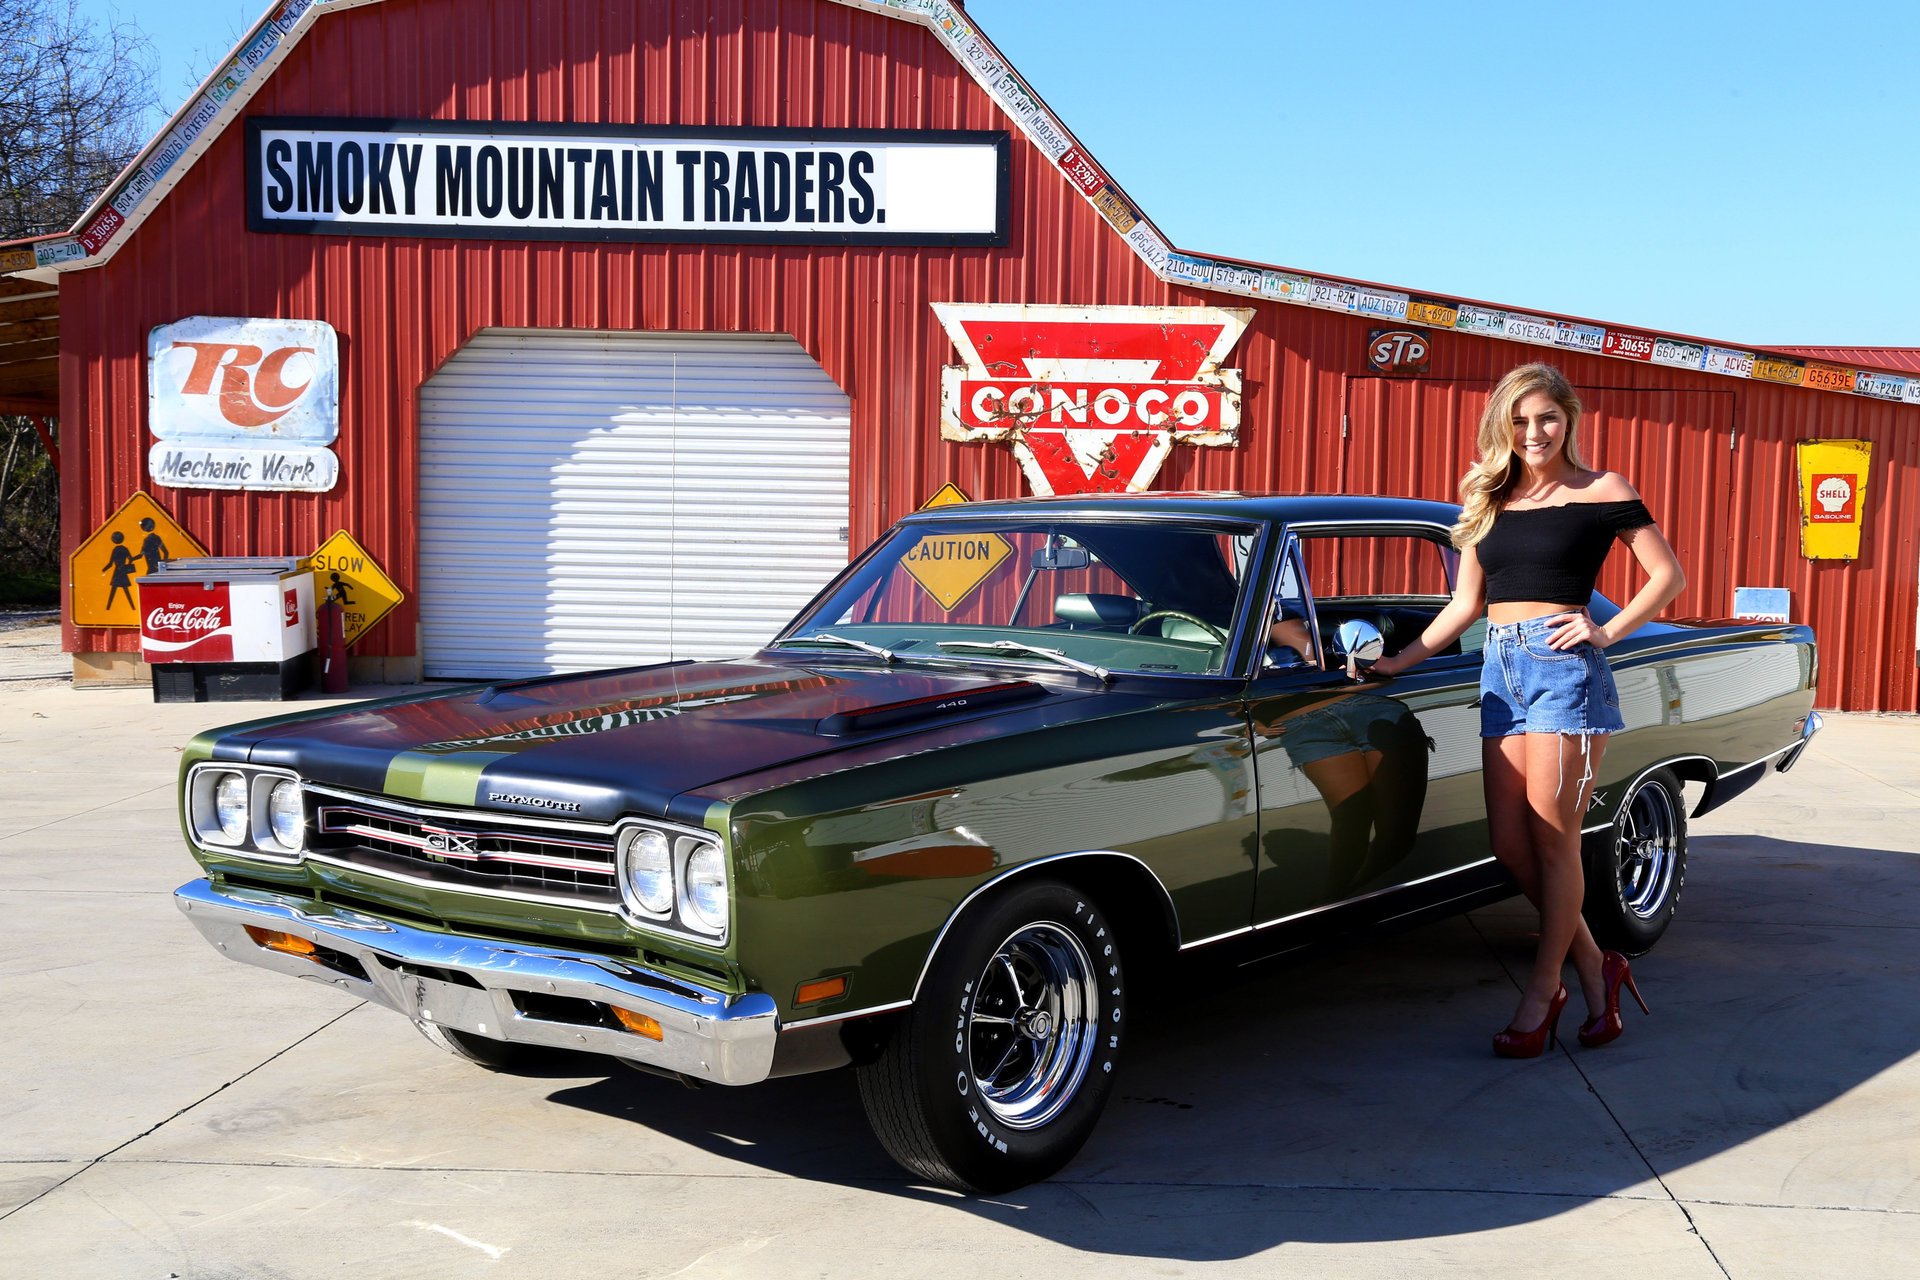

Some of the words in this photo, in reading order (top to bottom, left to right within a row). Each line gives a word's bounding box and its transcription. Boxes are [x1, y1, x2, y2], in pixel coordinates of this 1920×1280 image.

[184, 104, 217, 140] 6TXF815
[1031, 116, 1066, 154] N303652
[266, 139, 423, 215] SMOKY
[436, 144, 663, 222] MOUNTAIN
[676, 150, 885, 224] TRADERS.
[1129, 230, 1165, 267] 6PGJ412
[1315, 286, 1355, 305] 921-RZM
[1361, 295, 1406, 314] ADZ1678
[1508, 322, 1551, 340] 6SYE364
[1617, 332, 1644, 341] TENNESSEE
[1375, 336, 1425, 366] STP
[172, 341, 315, 427] RC
[1809, 369, 1850, 387] G5639E
[971, 385, 1210, 426] CONOCO
[160, 451, 252, 480] Mechanic
[262, 453, 315, 482] Work
[1820, 489, 1848, 499] SHELL
[908, 540, 990, 561] CAUTION
[315, 555, 364, 573] SLOW
[168, 602, 185, 610] Enjoy
[146, 606, 224, 630] Coca-Cola
[936, 700, 967, 709] 440
[488, 792, 581, 812] PLYMOUTH
[427, 834, 474, 853] GTX
[956, 980, 974, 1053] OVAL
[969, 1105, 1008, 1154] WIDE
